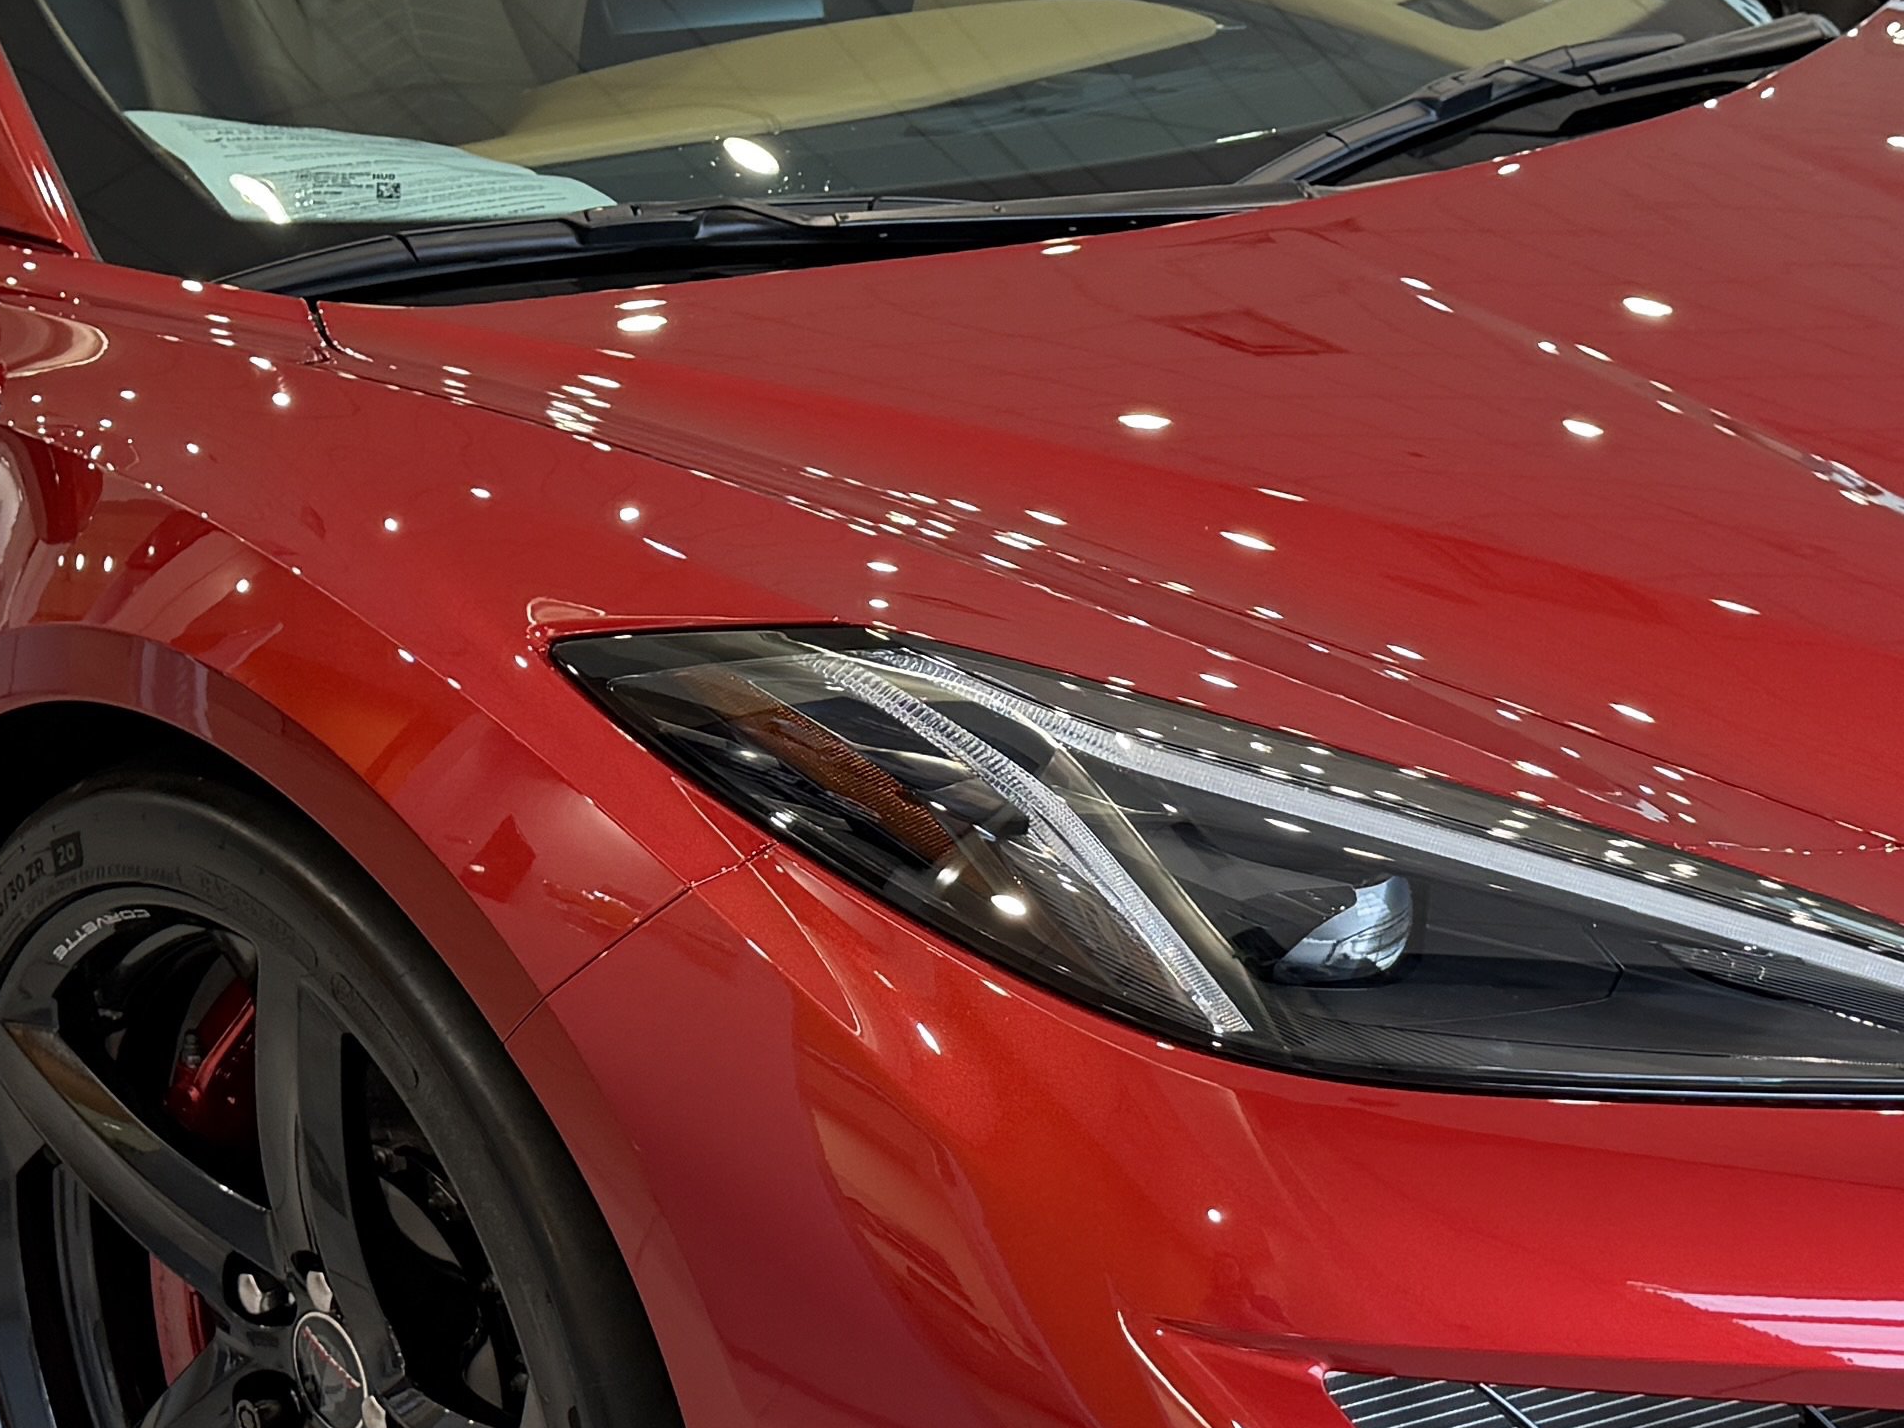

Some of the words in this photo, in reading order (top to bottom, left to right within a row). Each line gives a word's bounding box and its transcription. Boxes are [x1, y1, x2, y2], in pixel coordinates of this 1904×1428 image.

[25, 856, 48, 887] ZR
[55, 842, 76, 867] 20
[52, 908, 151, 962] CORVETTE
